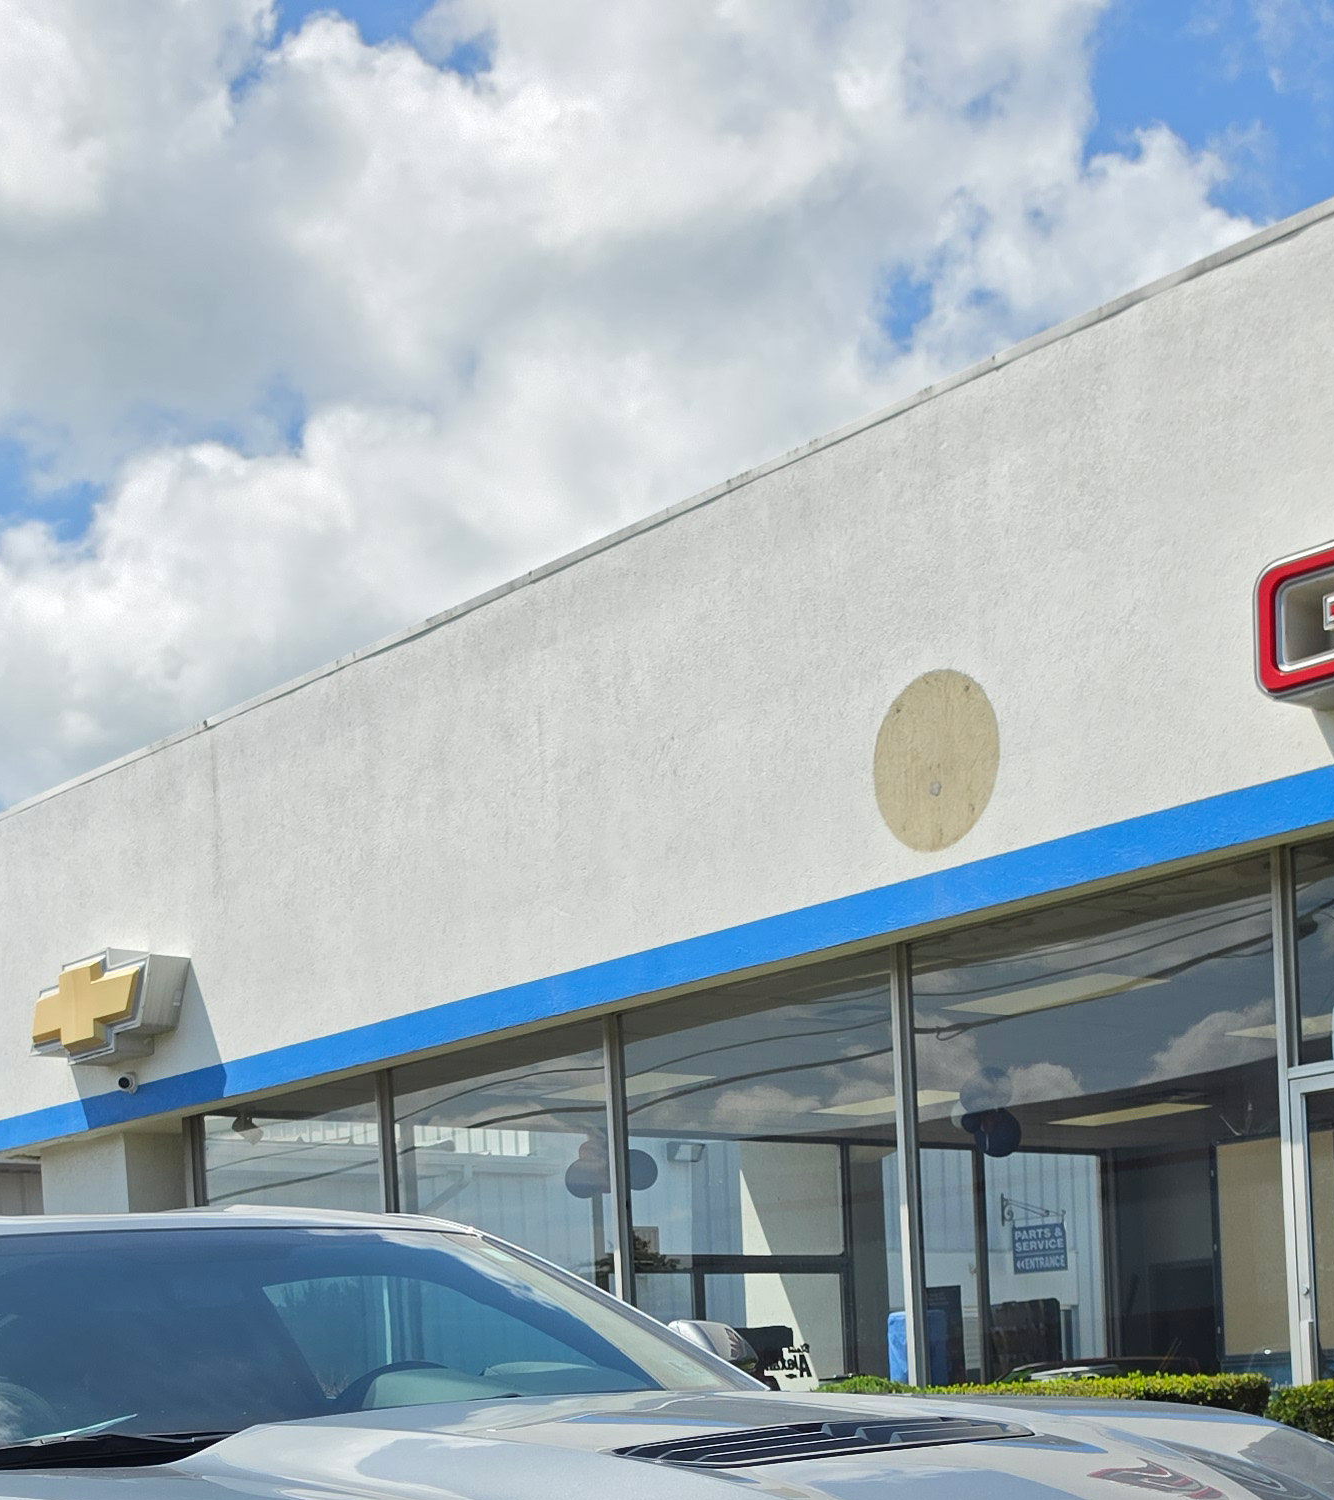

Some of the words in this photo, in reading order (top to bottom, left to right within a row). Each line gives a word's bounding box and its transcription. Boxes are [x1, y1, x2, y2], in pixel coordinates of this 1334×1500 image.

[1014, 1228, 1051, 1241] PARTS
[1054, 1227, 1063, 1237] &
[1015, 1238, 1065, 1252] SERVICE
[1024, 1255, 1066, 1271] ENTRANCE
